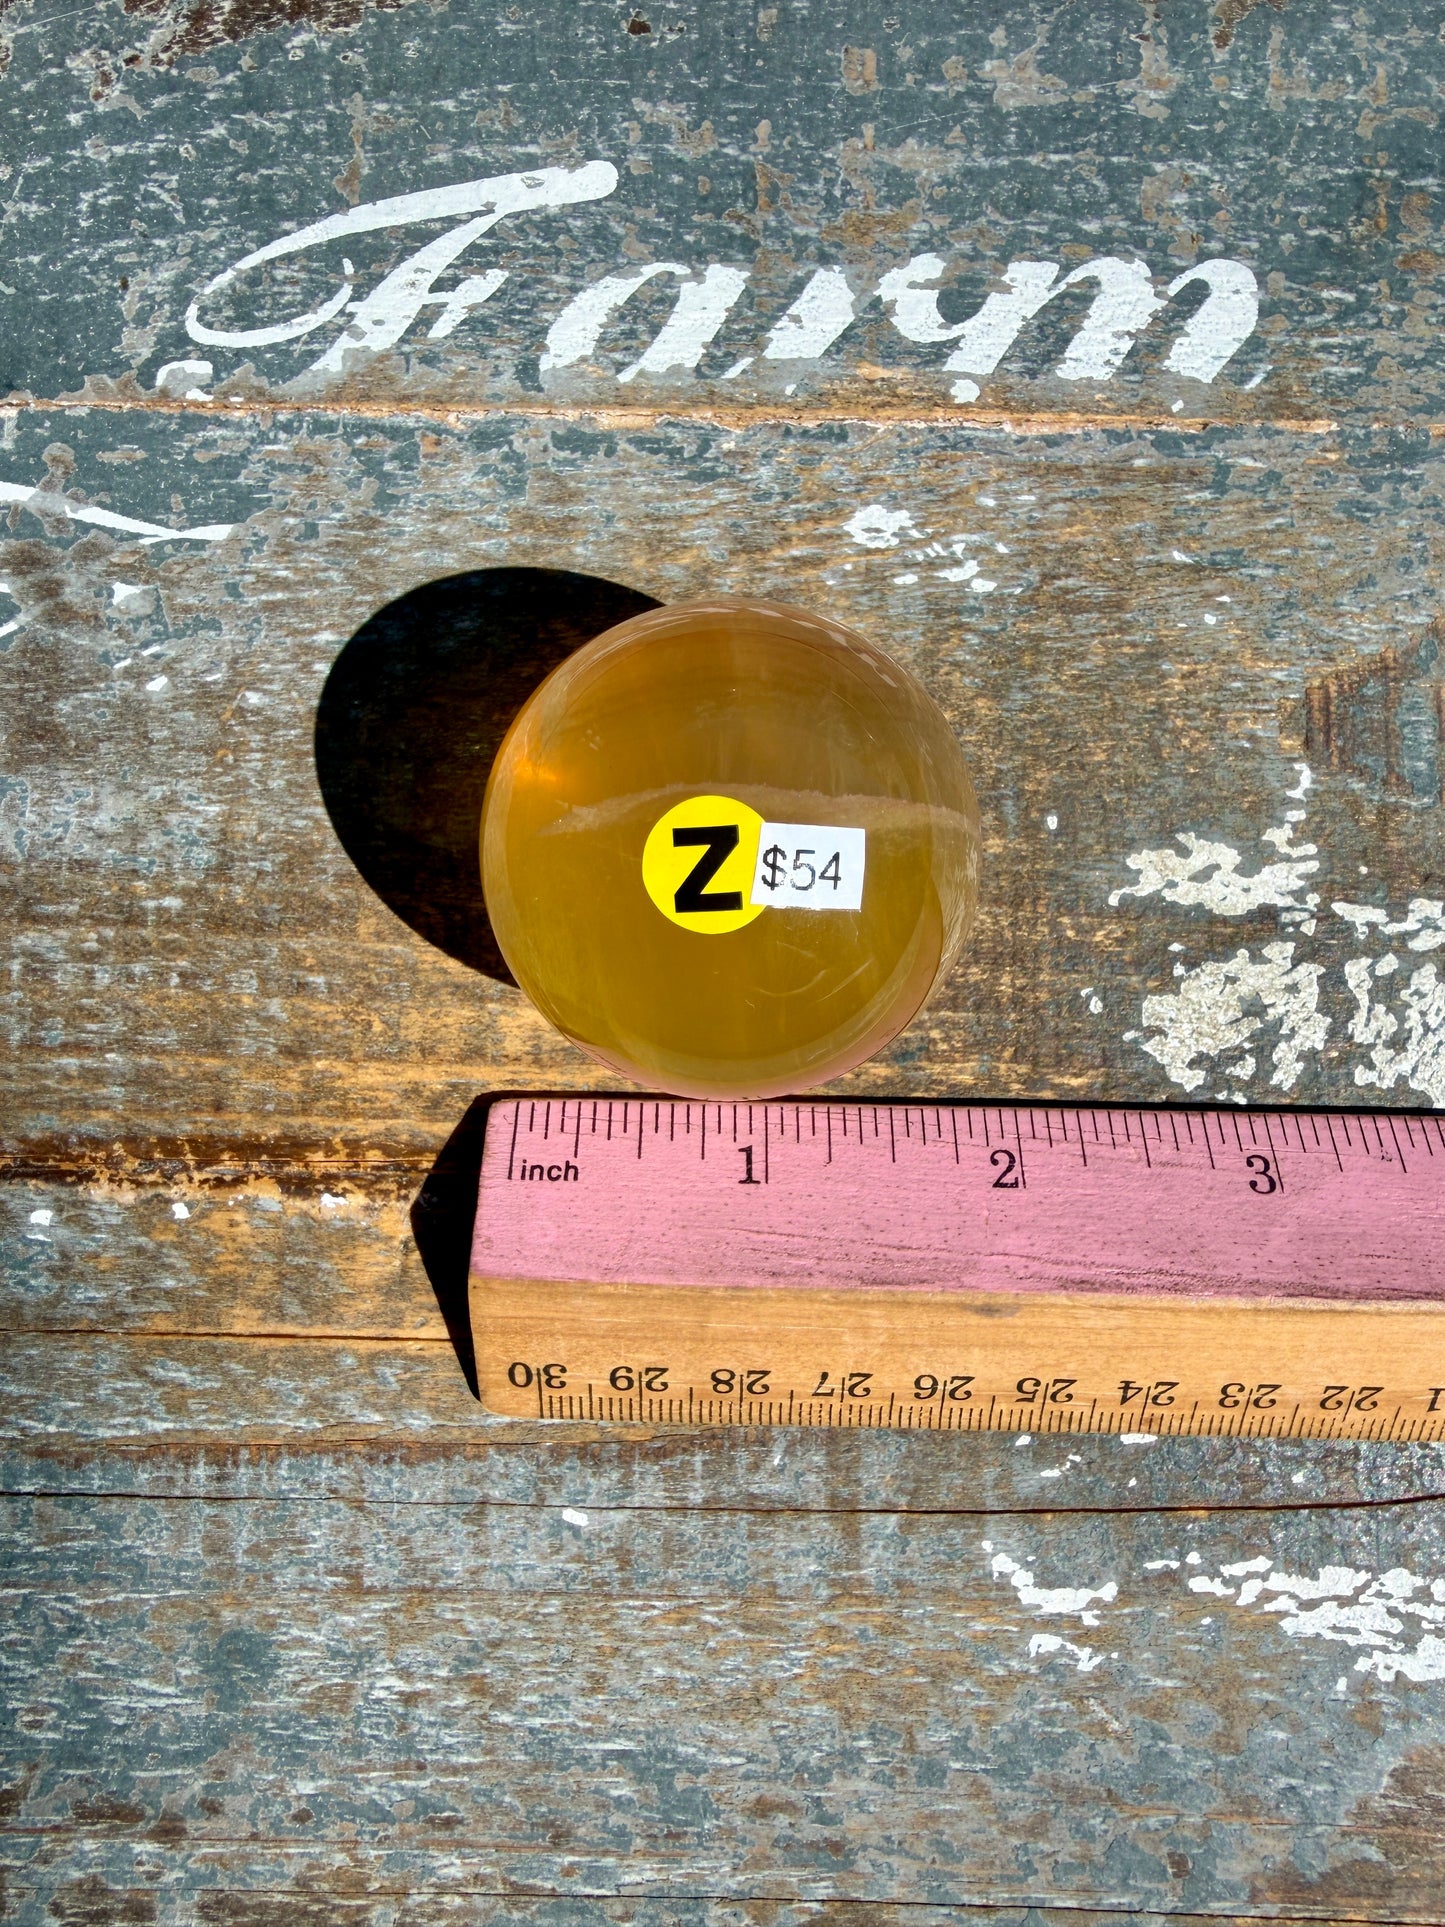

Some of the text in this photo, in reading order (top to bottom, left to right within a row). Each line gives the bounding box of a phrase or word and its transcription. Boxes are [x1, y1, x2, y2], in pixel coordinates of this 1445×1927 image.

[672, 824, 743, 913] Z
[761, 844, 842, 891] $54
[520, 1145, 1277, 1194] inch 1 2 3
[507, 1361, 1445, 1412] 1 22 23 24 25 26 27 28 29 30
